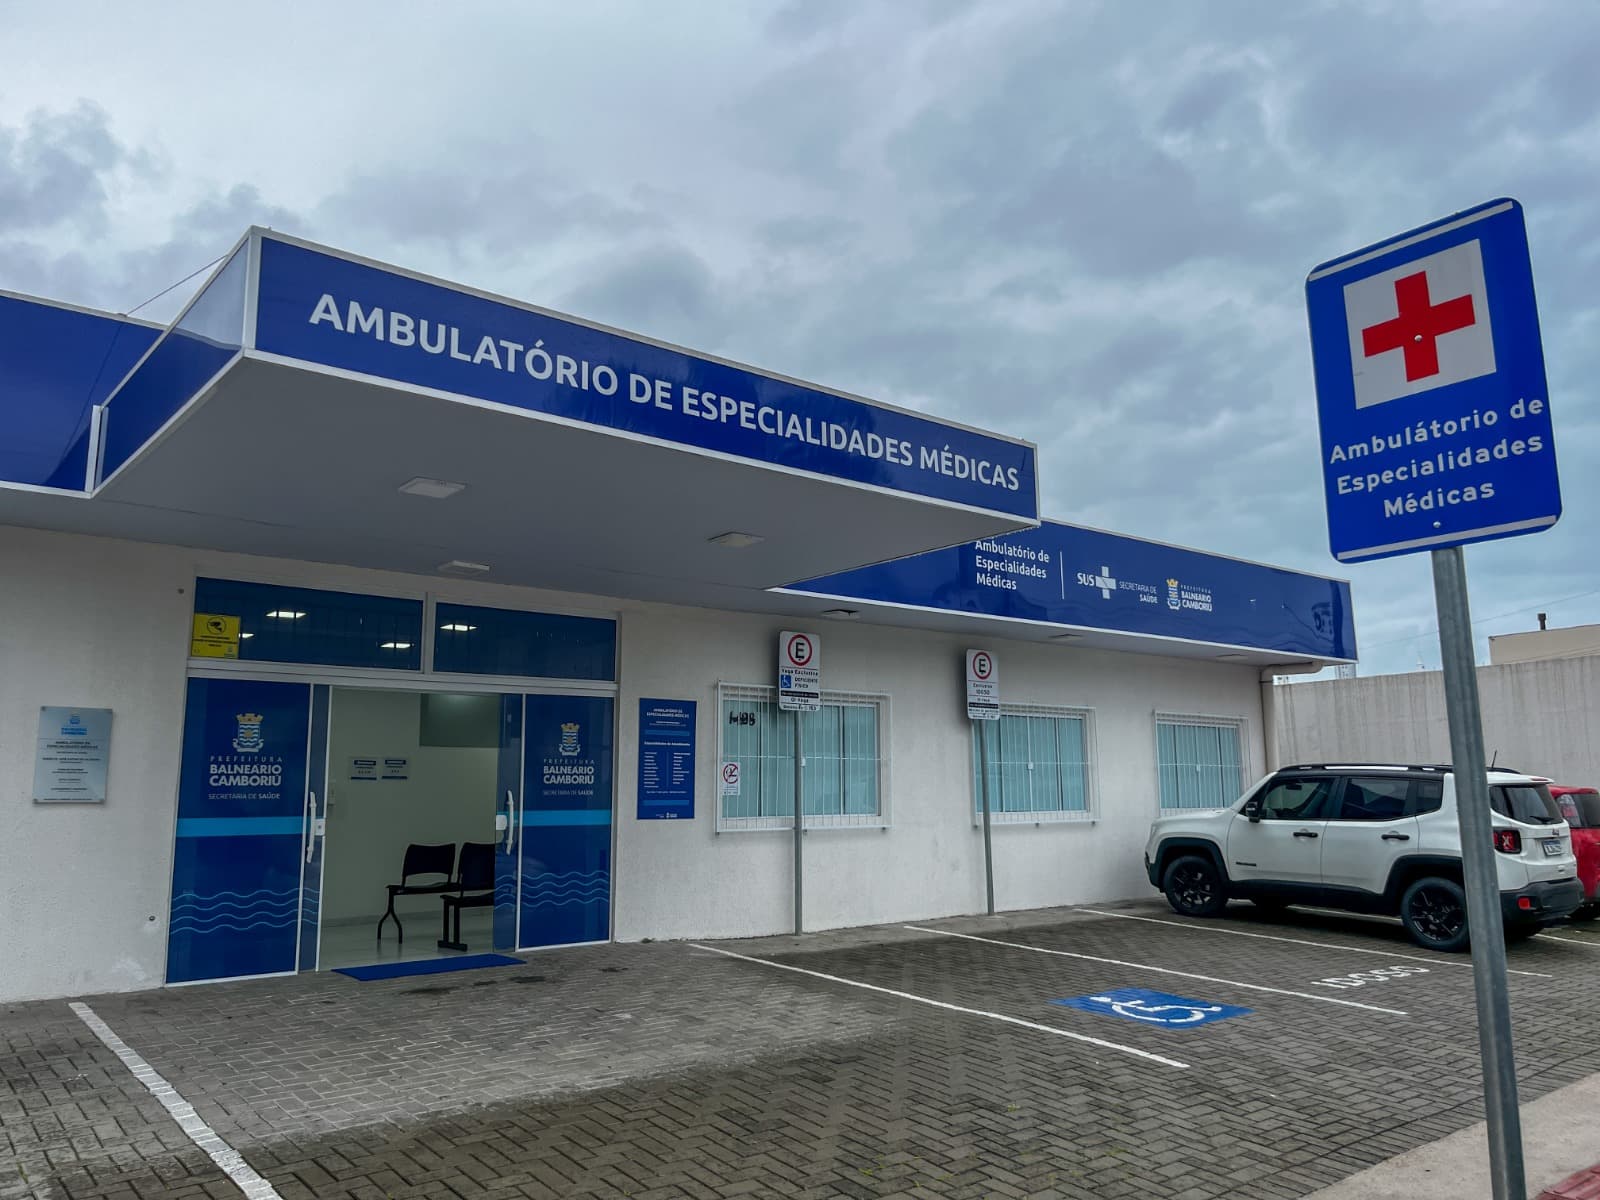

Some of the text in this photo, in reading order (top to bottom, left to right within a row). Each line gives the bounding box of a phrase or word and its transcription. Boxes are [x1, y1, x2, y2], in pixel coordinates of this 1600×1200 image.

[308, 293, 1020, 491] AMBULATÓRIO DE ESPECIALIDADES MÉDICAS
[1330, 398, 1544, 464] Ambulátorio de
[1337, 435, 1544, 495] Especialidades
[1384, 482, 1495, 518] Médicas
[975, 540, 1050, 563] Ambulatório de
[975, 555, 1047, 578] Especialidades
[976, 572, 1017, 590] Médicas
[1077, 572, 1095, 586] SUS
[1119, 581, 1150, 593] SECRETARIA
[795, 642, 805, 659] E
[979, 658, 986, 673] E
[209, 763, 282, 774] BALNEÁRIO
[543, 765, 595, 774] BALNEÁRIO
[209, 774, 282, 786] CAMBORIÚ
